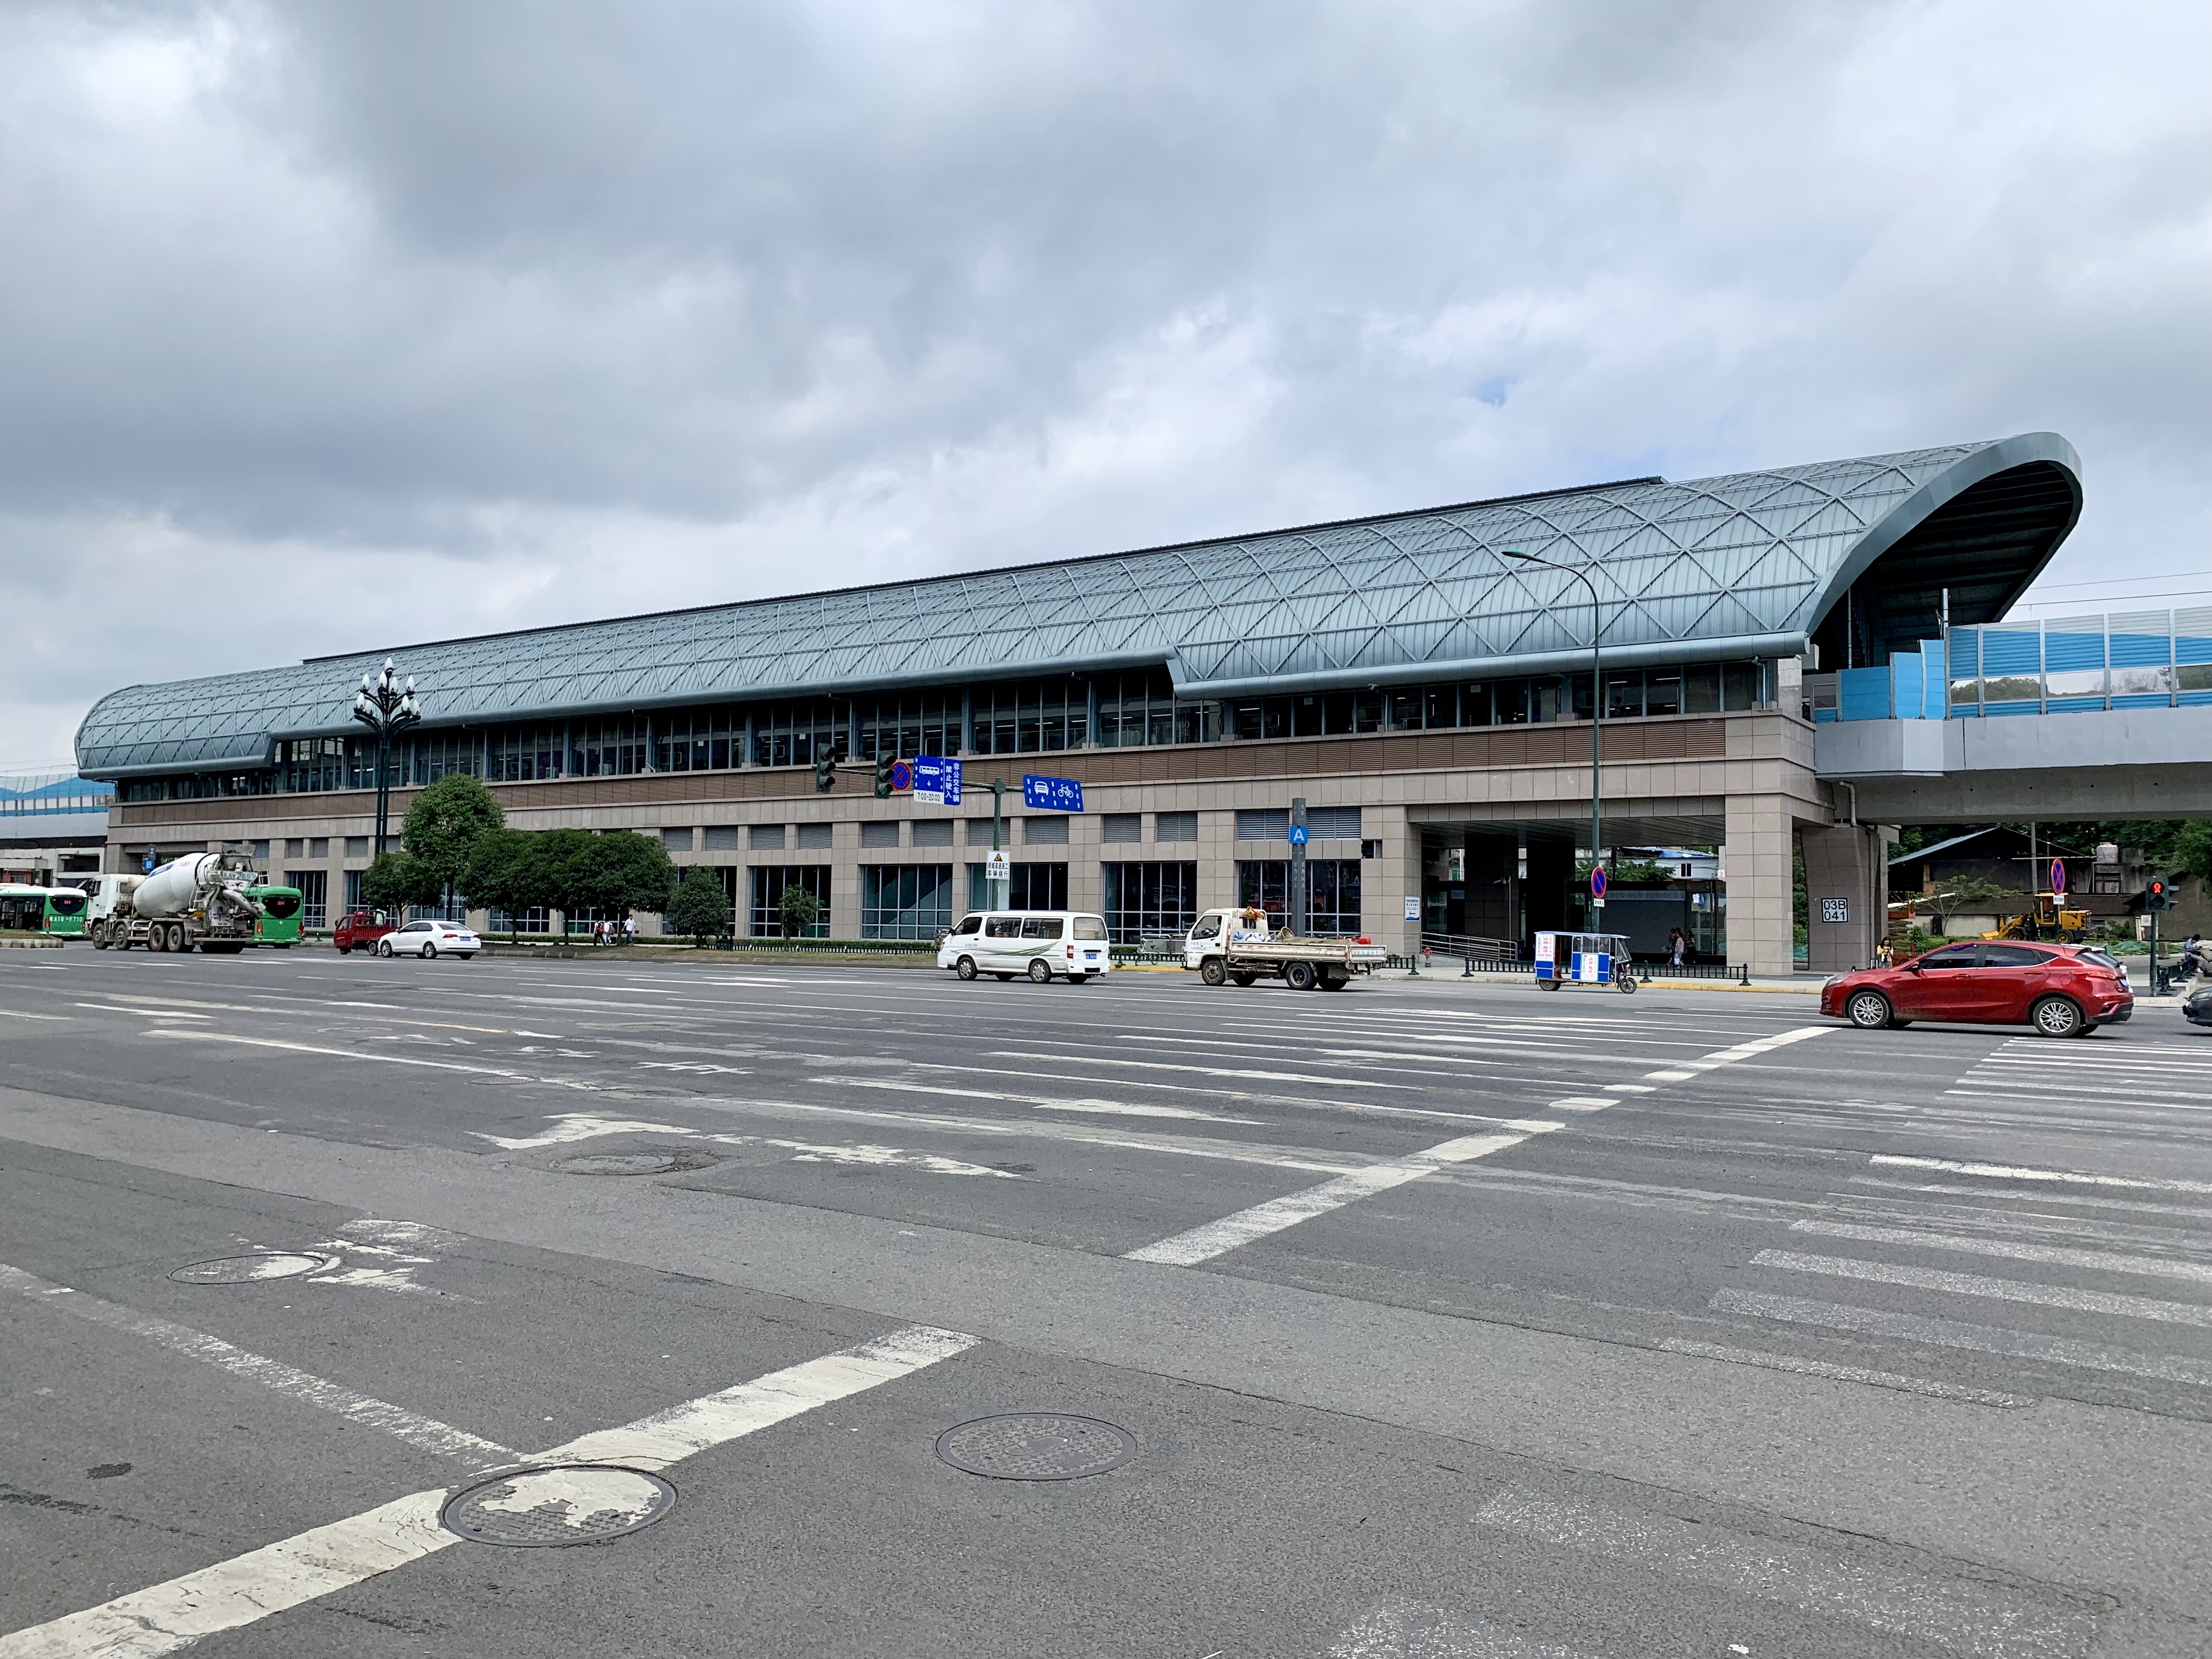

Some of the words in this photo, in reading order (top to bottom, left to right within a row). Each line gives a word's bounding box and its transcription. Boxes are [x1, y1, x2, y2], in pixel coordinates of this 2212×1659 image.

[917, 792, 940, 802] 7:00-20:00
[1293, 828, 1305, 841] A
[1824, 900, 1846, 910] 03B
[1824, 911, 1845, 921] 041
